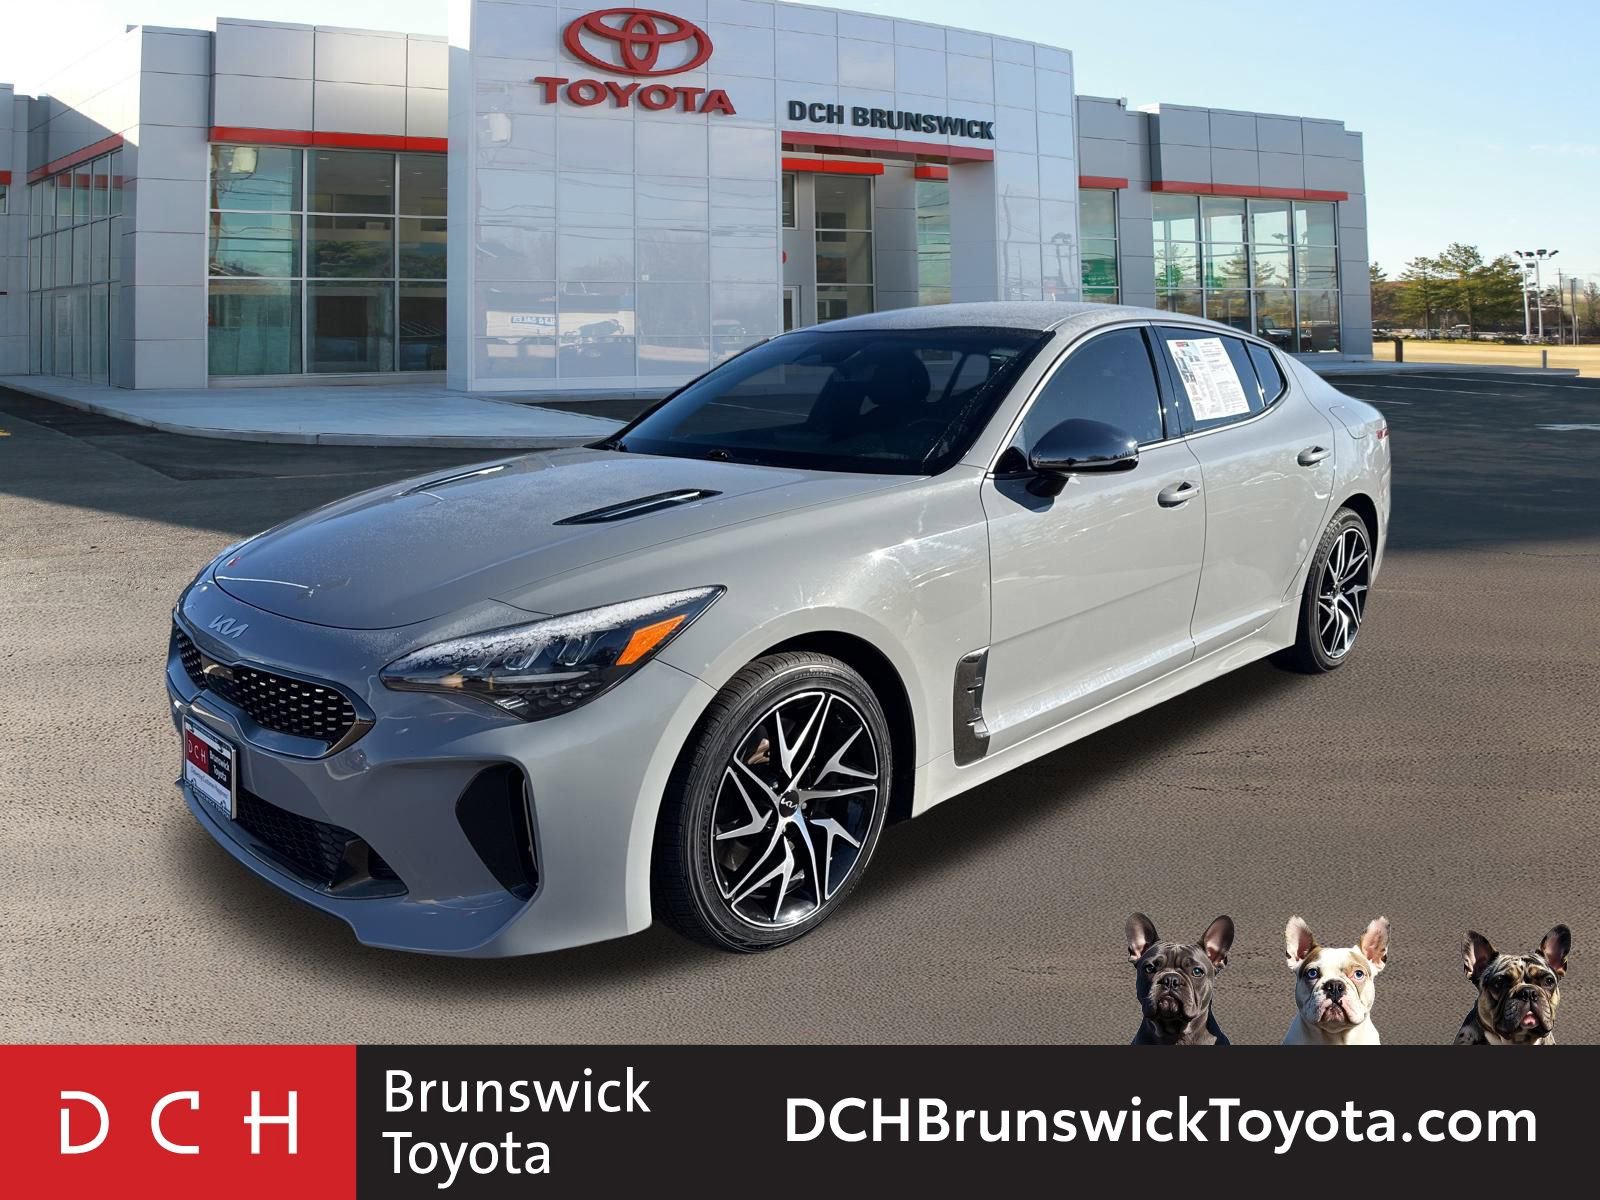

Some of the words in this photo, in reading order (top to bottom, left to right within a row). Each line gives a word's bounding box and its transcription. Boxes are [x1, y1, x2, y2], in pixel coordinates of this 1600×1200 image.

[535, 77, 736, 115] TOYOTA
[788, 100, 844, 124] DCH
[852, 106, 994, 140] BRUNSWICK
[208, 614, 249, 639] KIA
